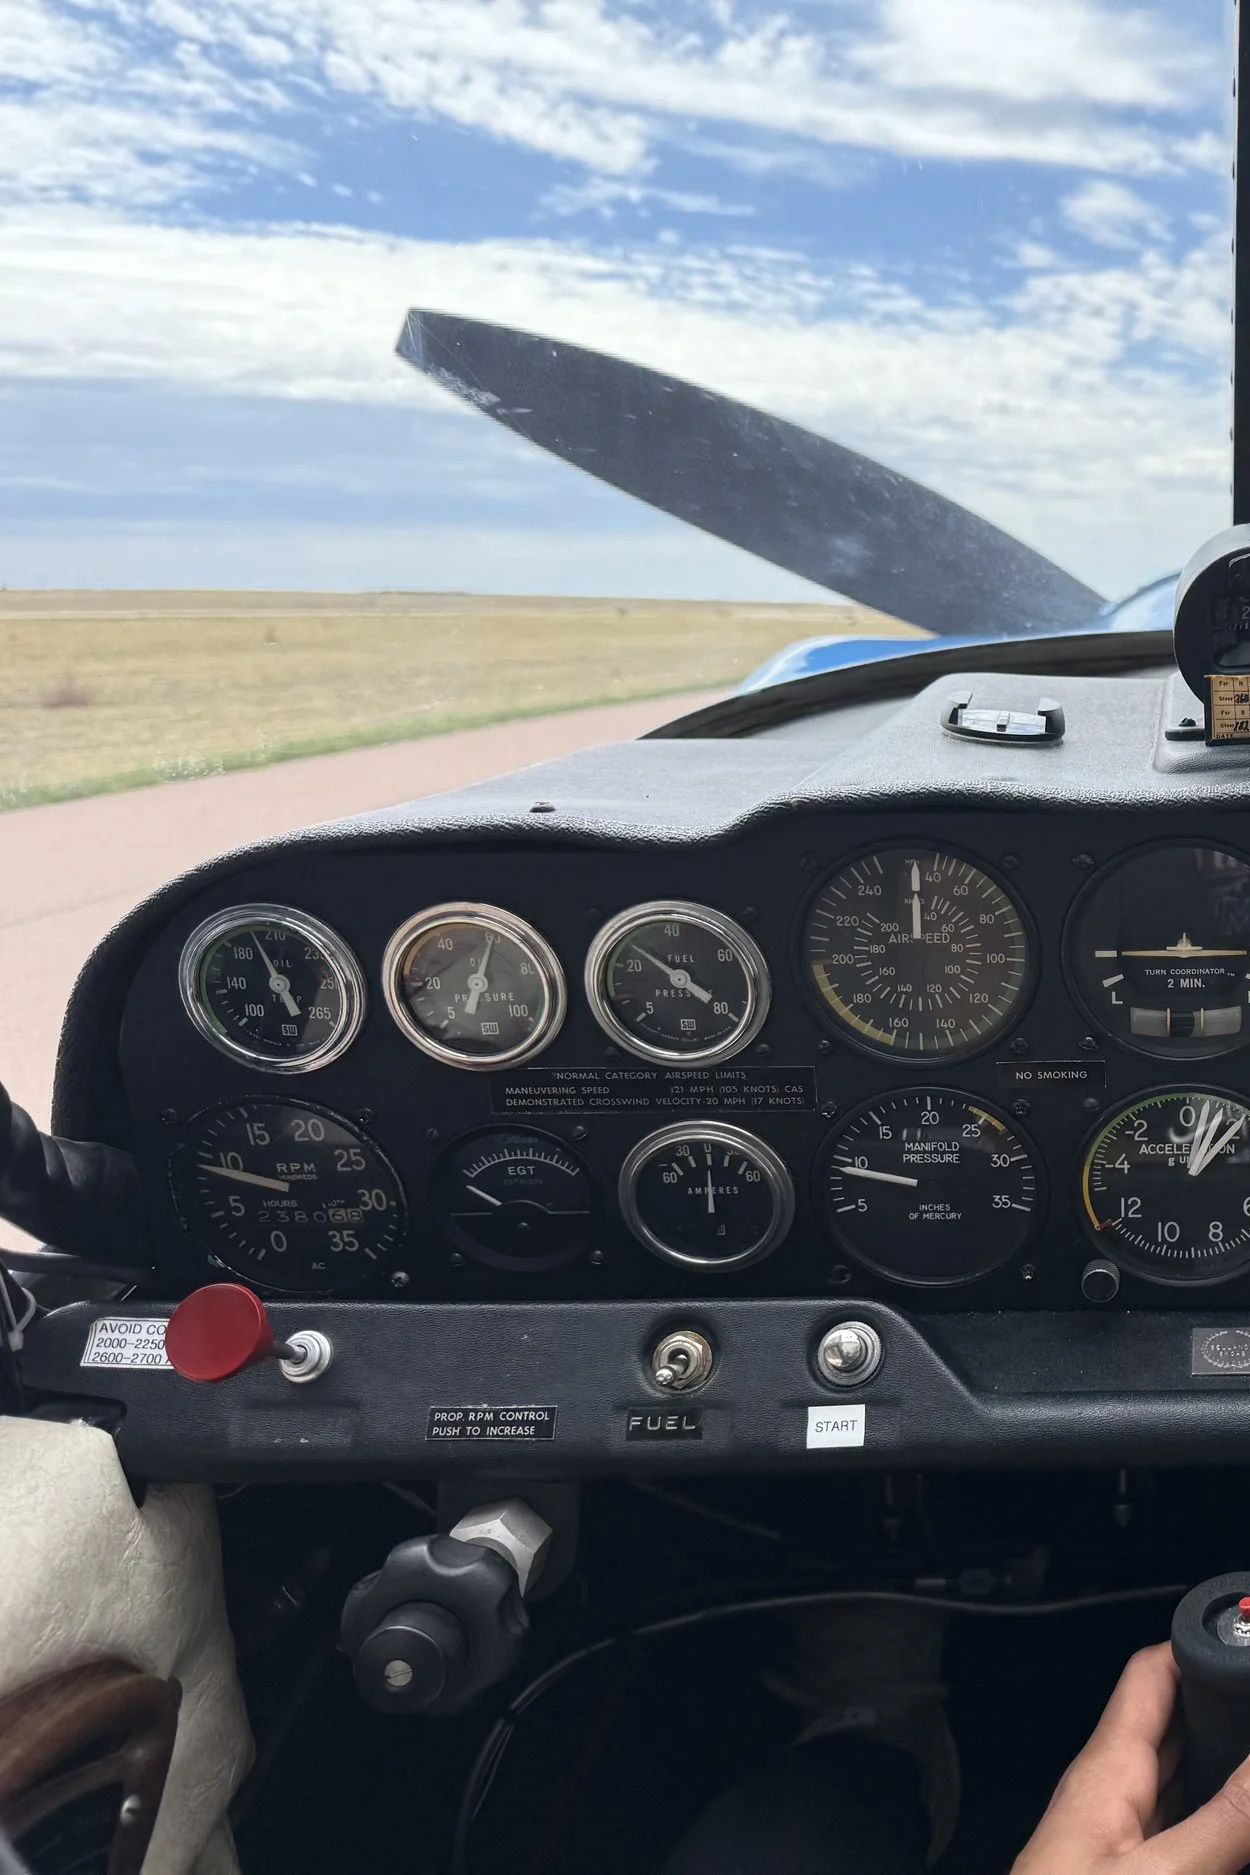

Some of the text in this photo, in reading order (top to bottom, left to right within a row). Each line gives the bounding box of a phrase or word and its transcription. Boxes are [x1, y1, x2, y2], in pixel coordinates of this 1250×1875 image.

[924, 871, 941, 883] 40
[923, 911, 938, 921] 40
[663, 923, 680, 938] 40
[950, 943, 964, 953] 80
[273, 959, 293, 968] OIL
[666, 954, 696, 964] FUEL
[1144, 967, 1226, 976] TURN COORDINATOR
[897, 983, 913, 993] 140
[1167, 978, 1206, 989] 2 MIN.
[1111, 991, 1124, 1005] L
[308, 1006, 331, 1020] 265
[936, 1018, 956, 1029] 140
[605, 1070, 657, 1080] CATEGORY
[665, 1070, 710, 1080] AIRSPEED
[1015, 1069, 1088, 1081] NO SMOKING
[505, 1083, 805, 1096] MANEUVERING SPEED 121 MPH (105 KNOTS) CAS
[506, 1098, 585, 1108] DEMONSTRATED
[589, 1097, 651, 1107] CROSSWIND
[723, 1096, 746, 1106] MPH
[769, 1095, 806, 1106] KNOTS)
[920, 1111, 940, 1125] 20
[290, 1118, 326, 1142] 20
[903, 1141, 960, 1151] MANIFOLD
[902, 1153, 960, 1164] PRESSURE
[990, 1153, 1010, 1168] 30
[1104, 1153, 1131, 1175] -4
[275, 1162, 317, 1173] RPM
[506, 1164, 536, 1177] EGT
[687, 1186, 740, 1196] AMPERES
[228, 1195, 246, 1217] 5
[262, 1199, 299, 1208] HOURS
[919, 1203, 951, 1211] INCHES
[908, 1212, 962, 1220] OF MERCURY
[1208, 1220, 1224, 1243] 8
[99, 1323, 143, 1335] AVOID
[95, 1337, 166, 1350] 2000-2250
[91, 1351, 162, 1364] 2600-2700
[434, 1411, 550, 1421] PROP. RPM CONTROL
[629, 1415, 696, 1431] FUEL
[814, 1419, 859, 1434] START
[432, 1425, 535, 1436] PUSH TO INCREASE
